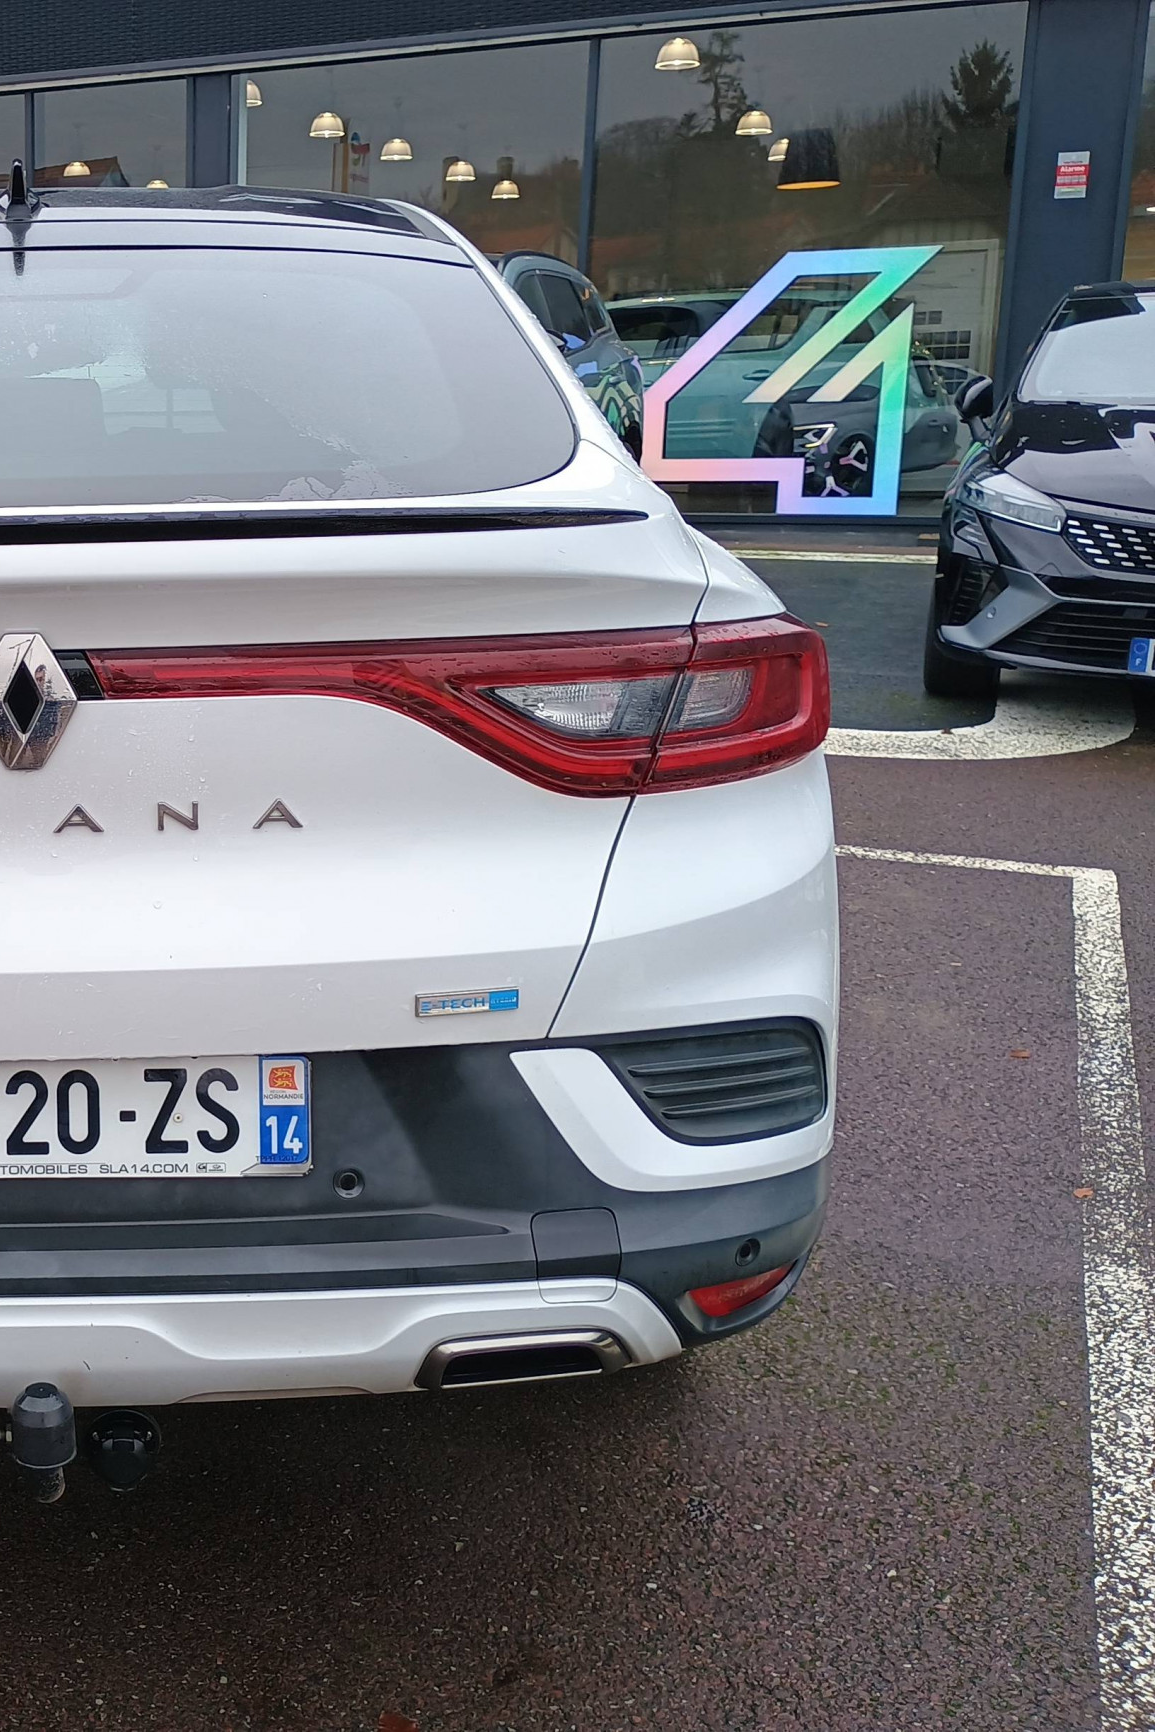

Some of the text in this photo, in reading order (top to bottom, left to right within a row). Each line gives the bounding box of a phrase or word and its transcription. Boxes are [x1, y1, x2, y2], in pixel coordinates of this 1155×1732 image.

[421, 997, 486, 1014] E-TECH
[265, 1115, 303, 1154] 14
[99, 1163, 189, 1174] SLA14.COM
